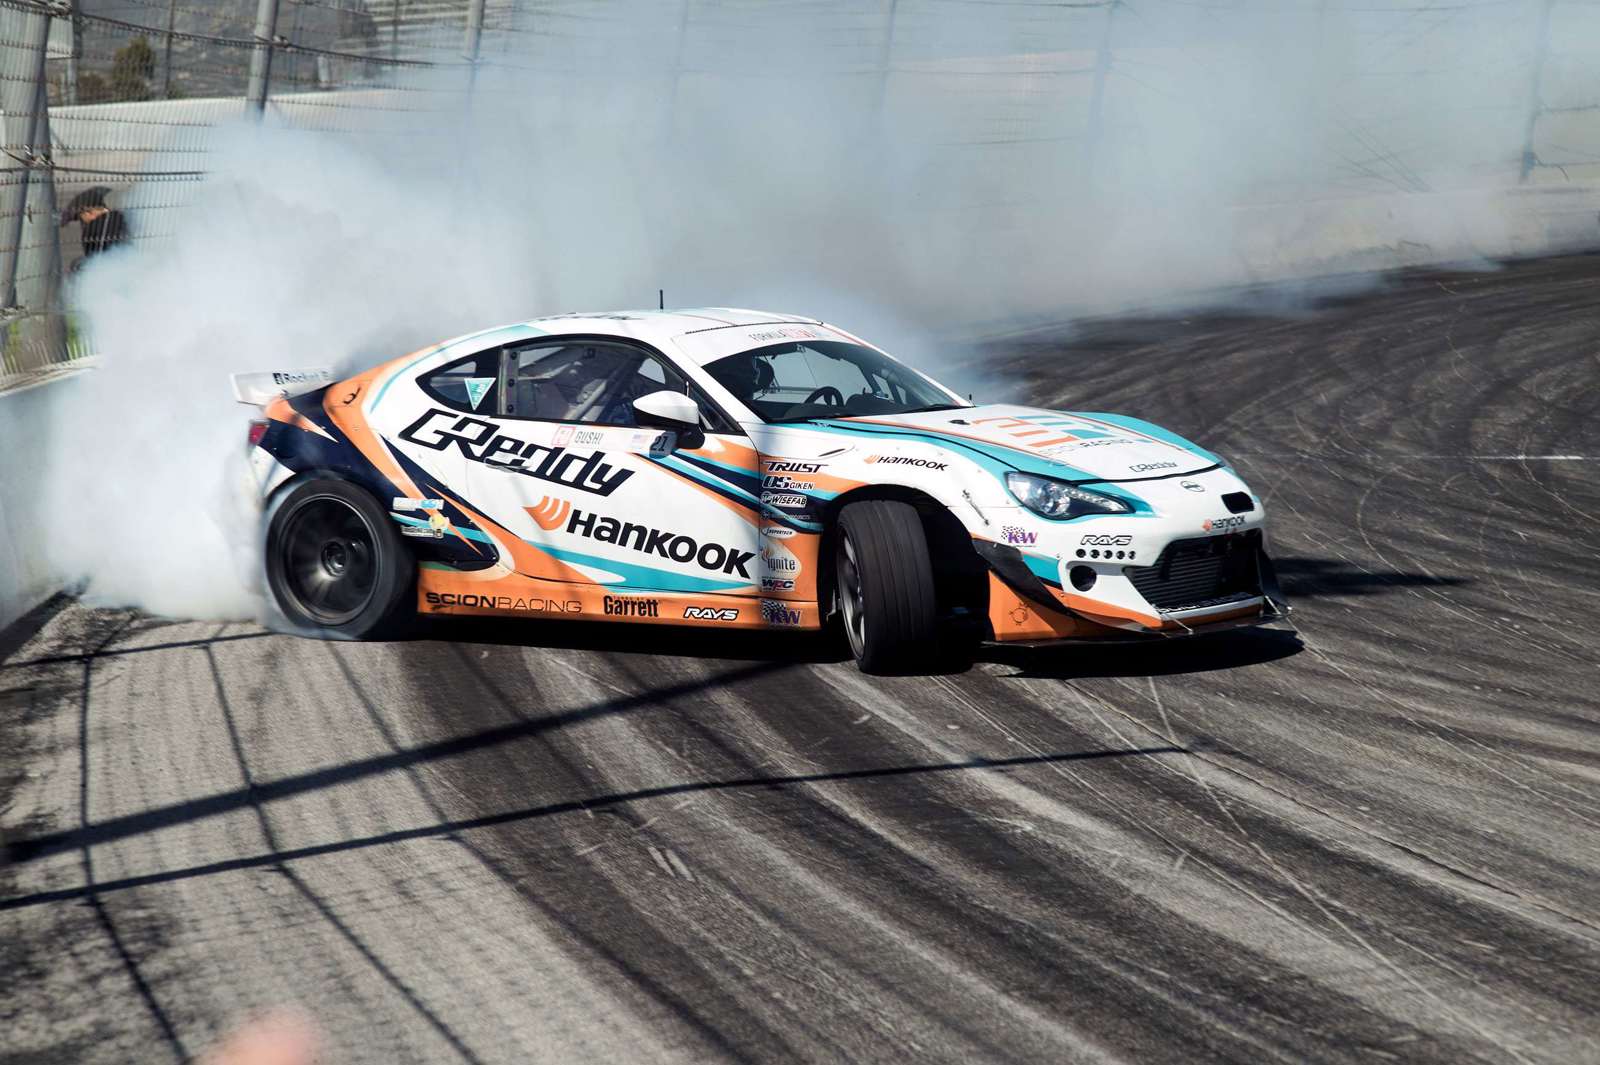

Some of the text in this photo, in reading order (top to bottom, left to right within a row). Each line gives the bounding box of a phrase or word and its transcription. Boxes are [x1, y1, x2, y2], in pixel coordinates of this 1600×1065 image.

[763, 461, 829, 474] TRUST
[772, 494, 808, 505] WISEFAB
[1080, 534, 1133, 546] RAYS
[761, 579, 794, 591] WPC
[603, 595, 659, 618] Garrett
[683, 606, 739, 621] RAYS
